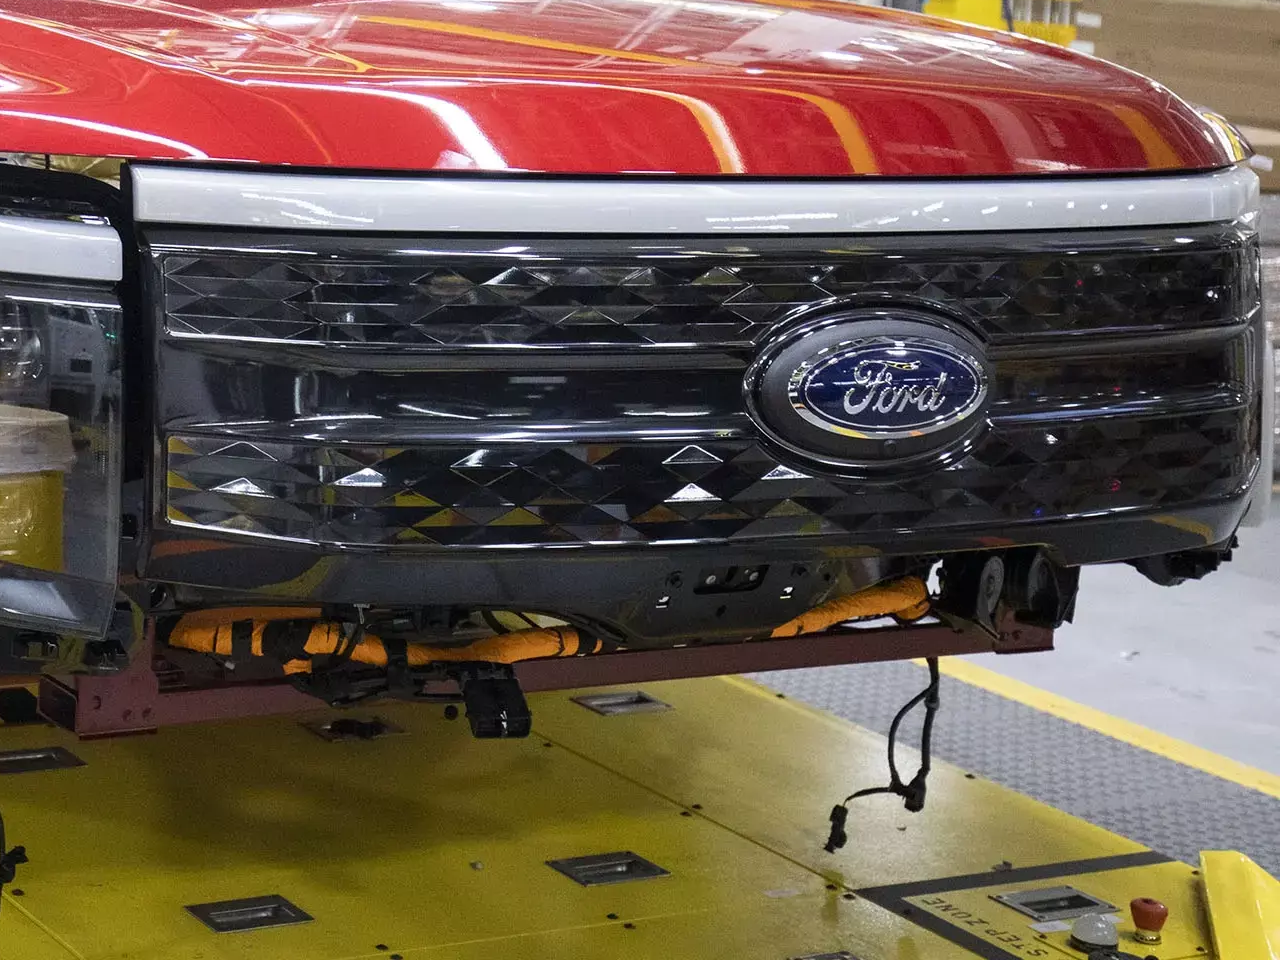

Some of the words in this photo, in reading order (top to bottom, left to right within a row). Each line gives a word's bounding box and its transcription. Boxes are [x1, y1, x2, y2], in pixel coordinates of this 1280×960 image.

[842, 359, 949, 415] Ford
[922, 896, 990, 927] ZONE
[984, 928, 1049, 957] STEP
